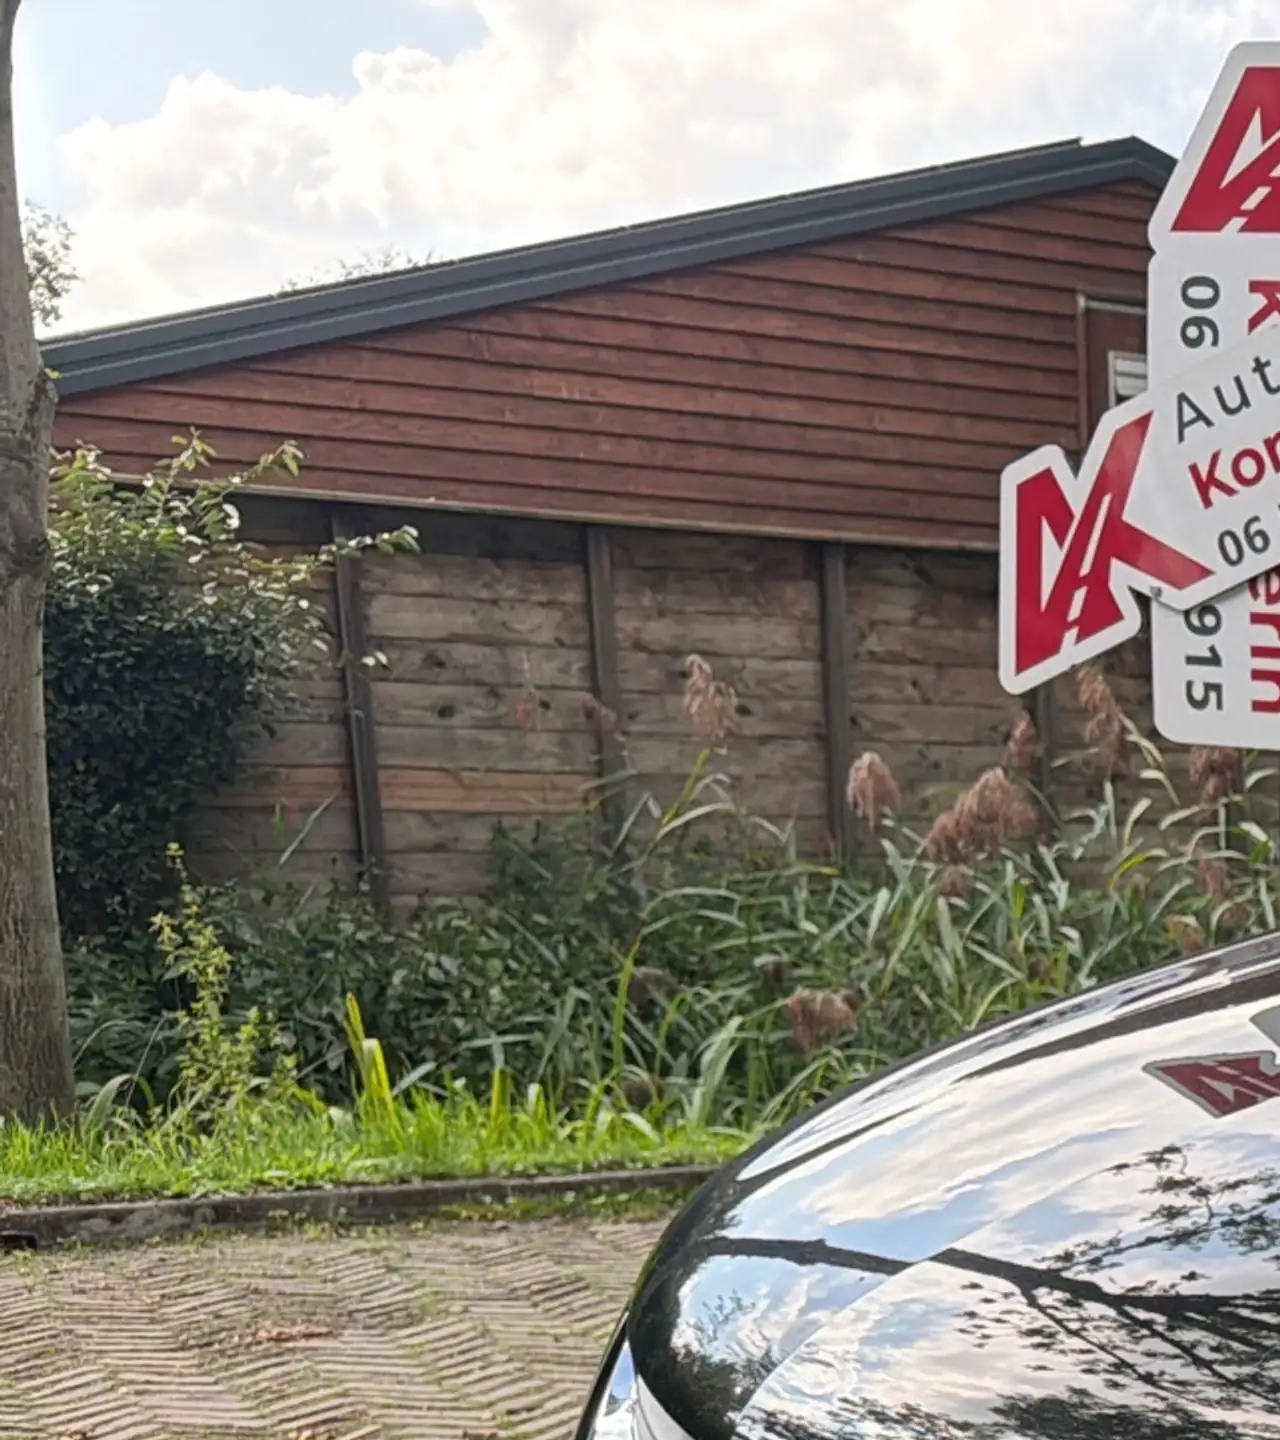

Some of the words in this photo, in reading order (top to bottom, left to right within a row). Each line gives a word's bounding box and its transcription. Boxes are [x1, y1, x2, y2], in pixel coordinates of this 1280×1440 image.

[1180, 276, 1220, 349] 06
[1217, 515, 1271, 567] 06
[1184, 604, 1224, 712] 915
